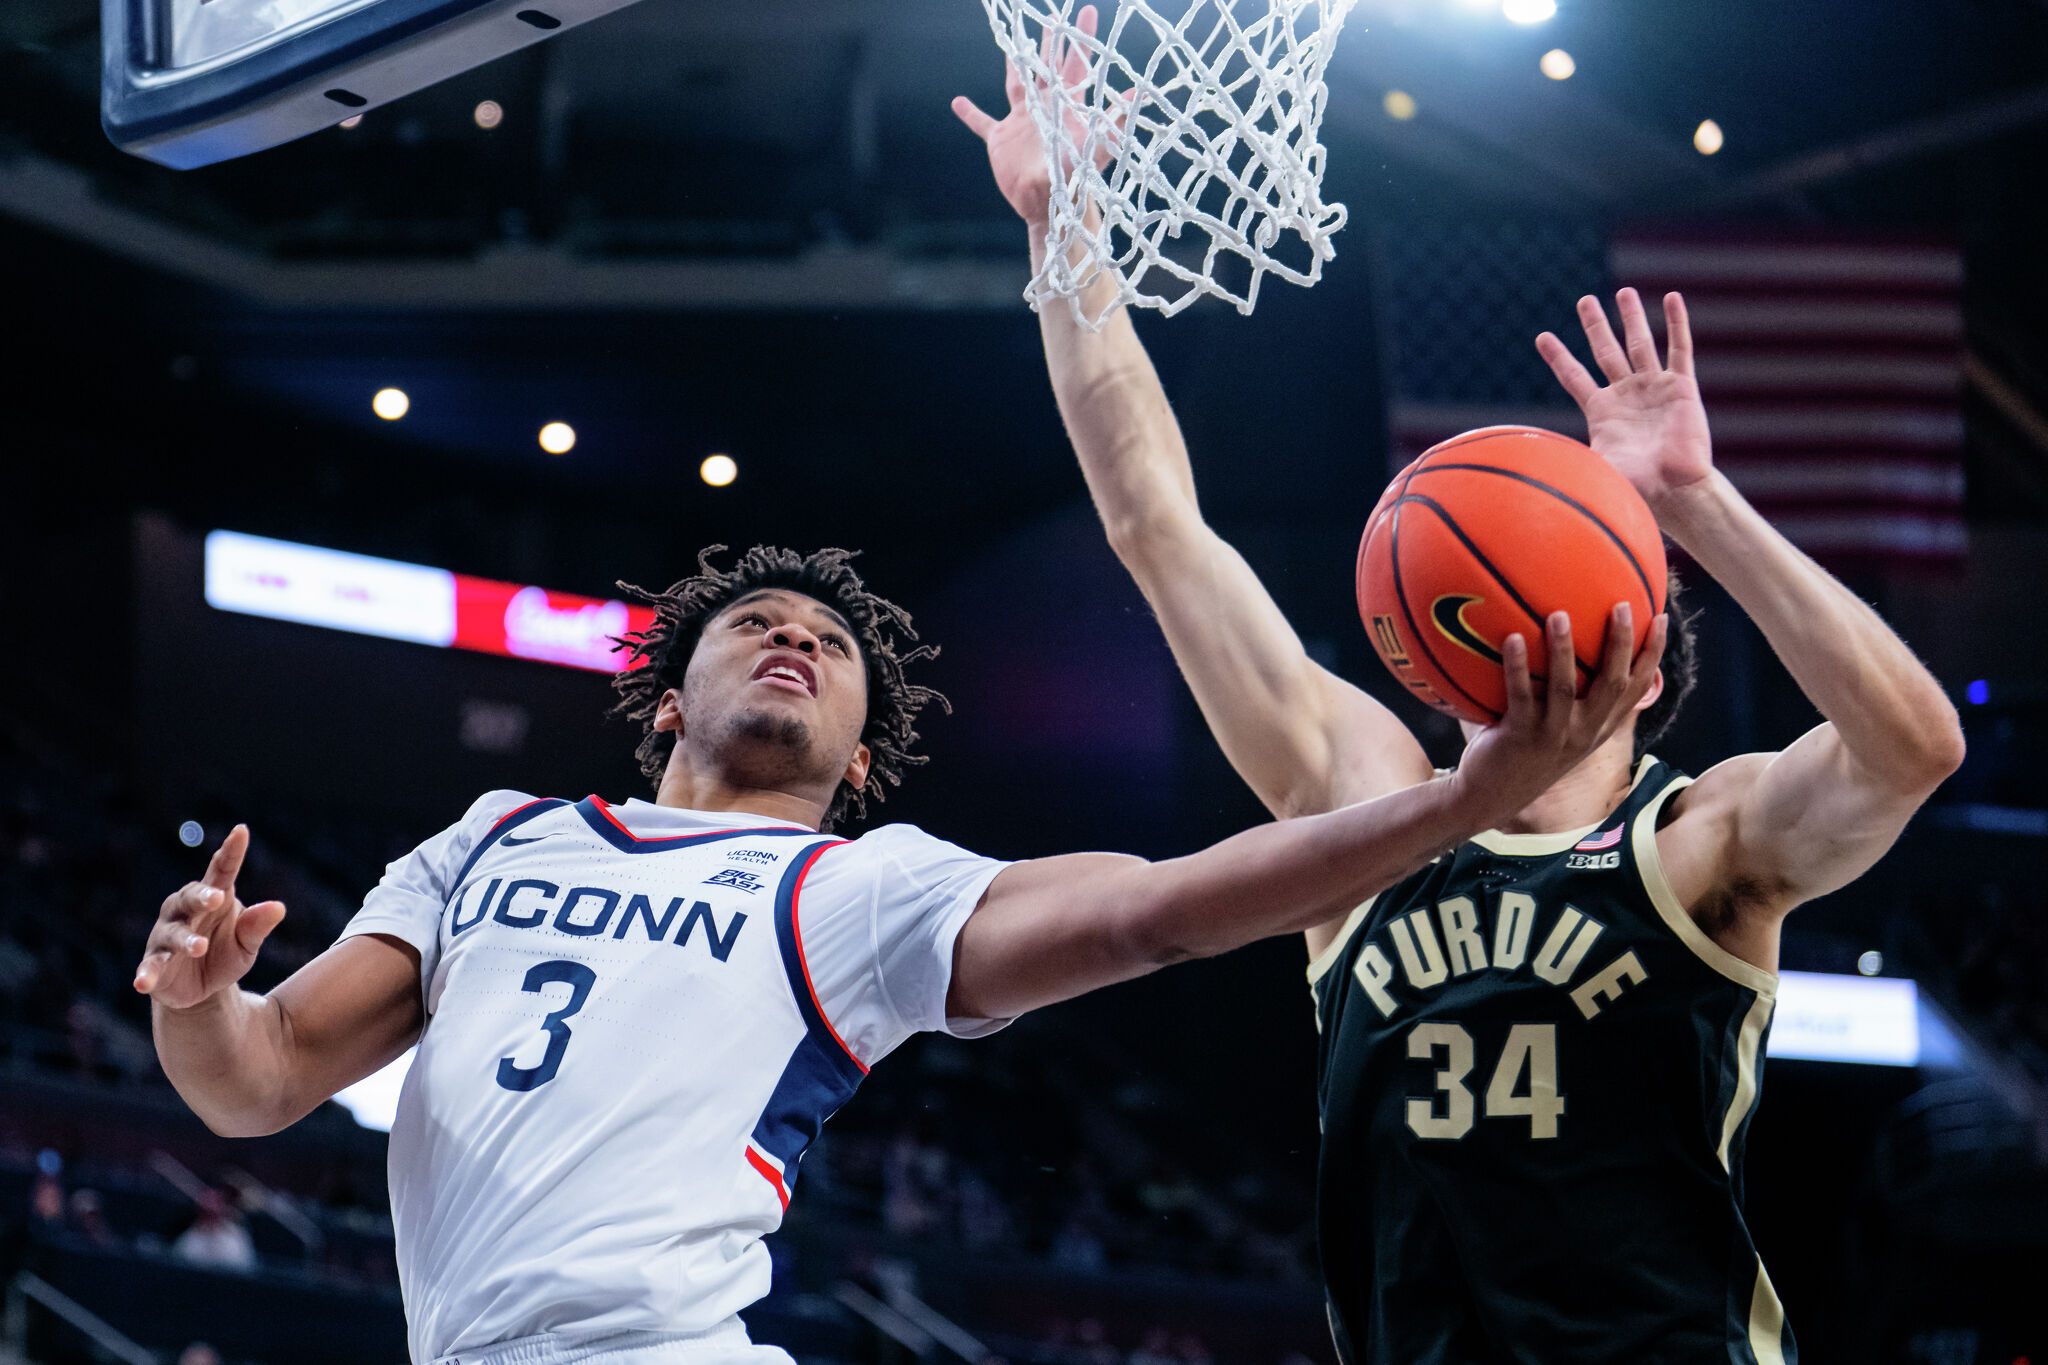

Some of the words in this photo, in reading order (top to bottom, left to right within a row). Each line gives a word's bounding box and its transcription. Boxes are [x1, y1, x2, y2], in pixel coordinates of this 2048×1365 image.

[719, 869, 761, 881] BIG
[727, 850, 779, 862] UCONN
[728, 856, 769, 865] HEALTH
[708, 875, 765, 891] EAST
[451, 878, 748, 963] UCONN
[1352, 889, 1652, 1024] PURDUE
[495, 959, 597, 1092] 3
[1404, 1020, 1568, 1141] 34
